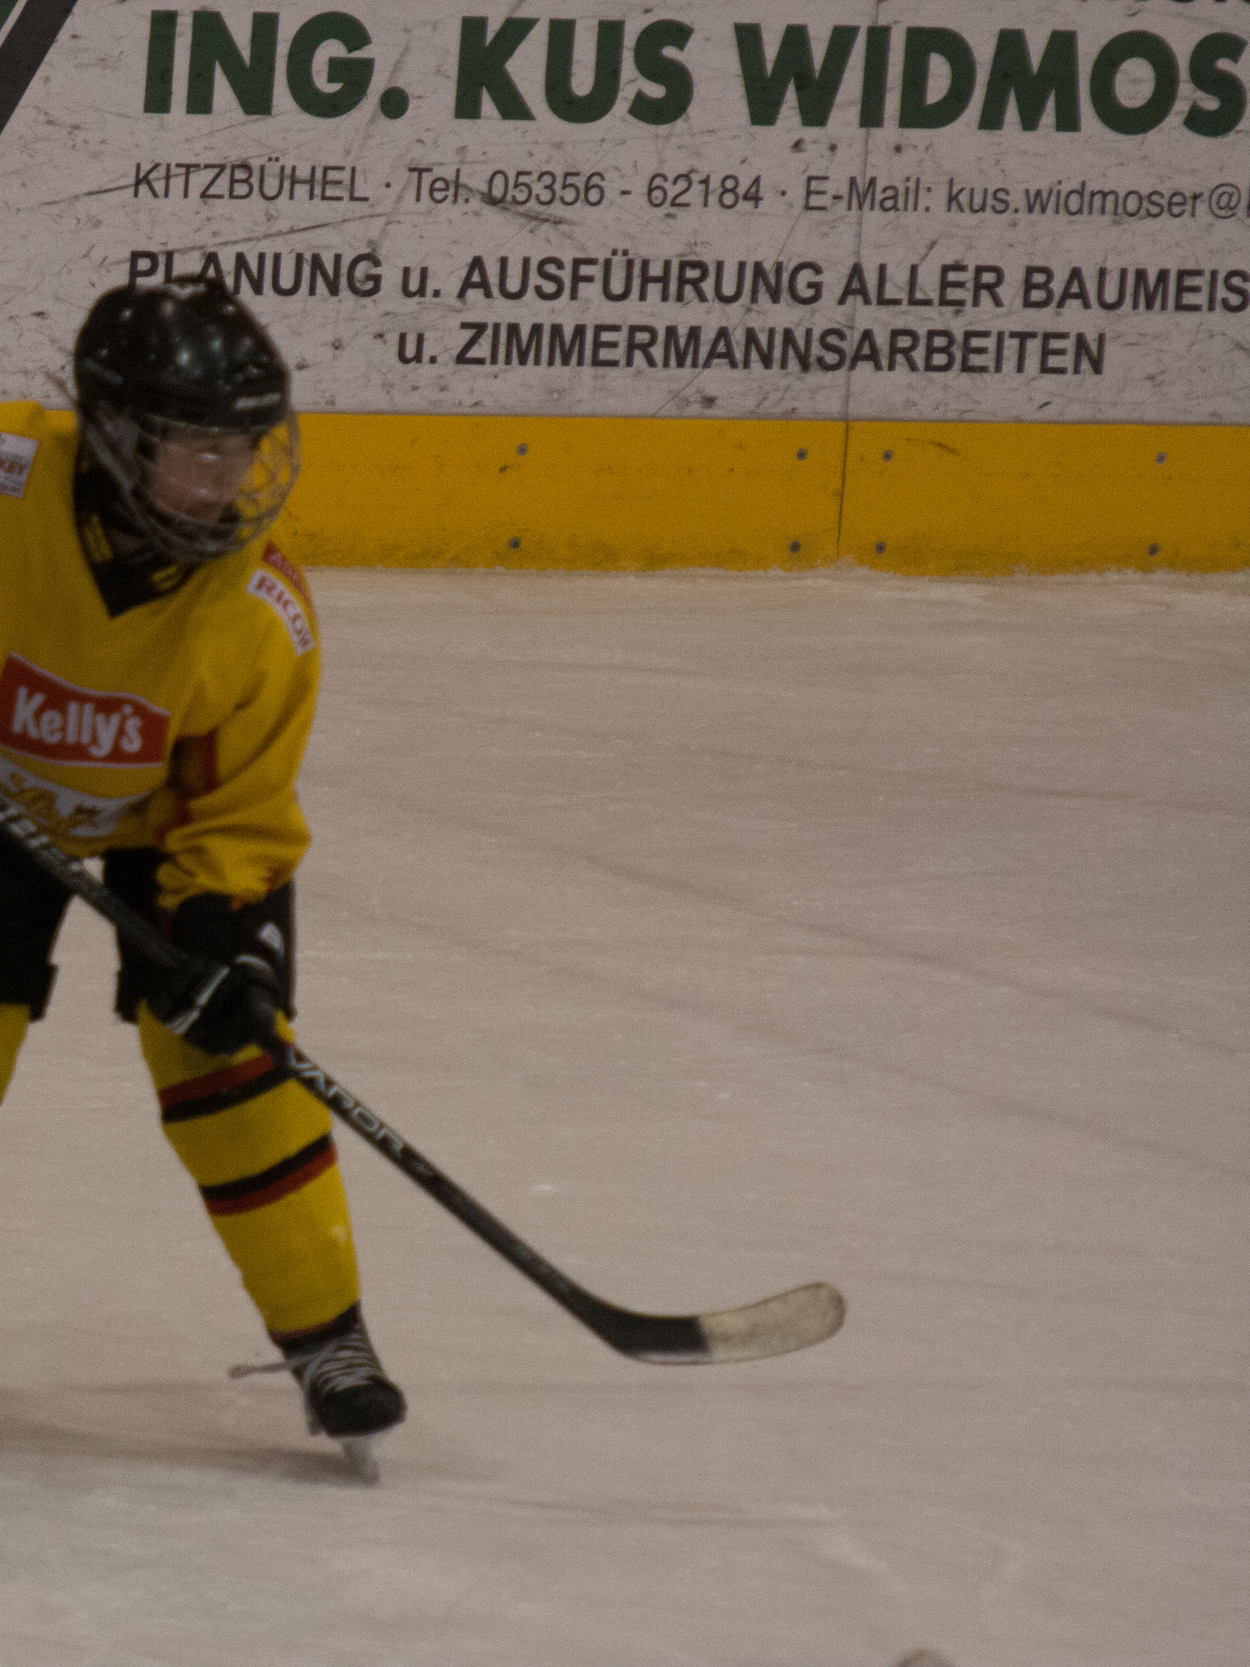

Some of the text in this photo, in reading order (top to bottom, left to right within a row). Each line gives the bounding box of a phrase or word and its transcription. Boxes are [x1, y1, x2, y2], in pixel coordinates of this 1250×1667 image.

[143, 10, 1248, 138] ING. KUS WIDMOS
[132, 157, 370, 203] KITZBÜHEL
[408, 166, 470, 205] Tel.
[487, 170, 606, 206] 05356
[646, 172, 764, 210] 62184
[803, 175, 932, 213] E-Mail:
[946, 180, 1250, 220] kus.widmoser@
[127, 249, 1250, 313] PLANUNG u. AUSFÜHRUNG ALLER BAUMEIS
[397, 322, 1106, 375] u. ZIMMERMANNSARBEITEN
[10, 685, 143, 758] Kelly's
[285, 1045, 409, 1158] VAPOR
